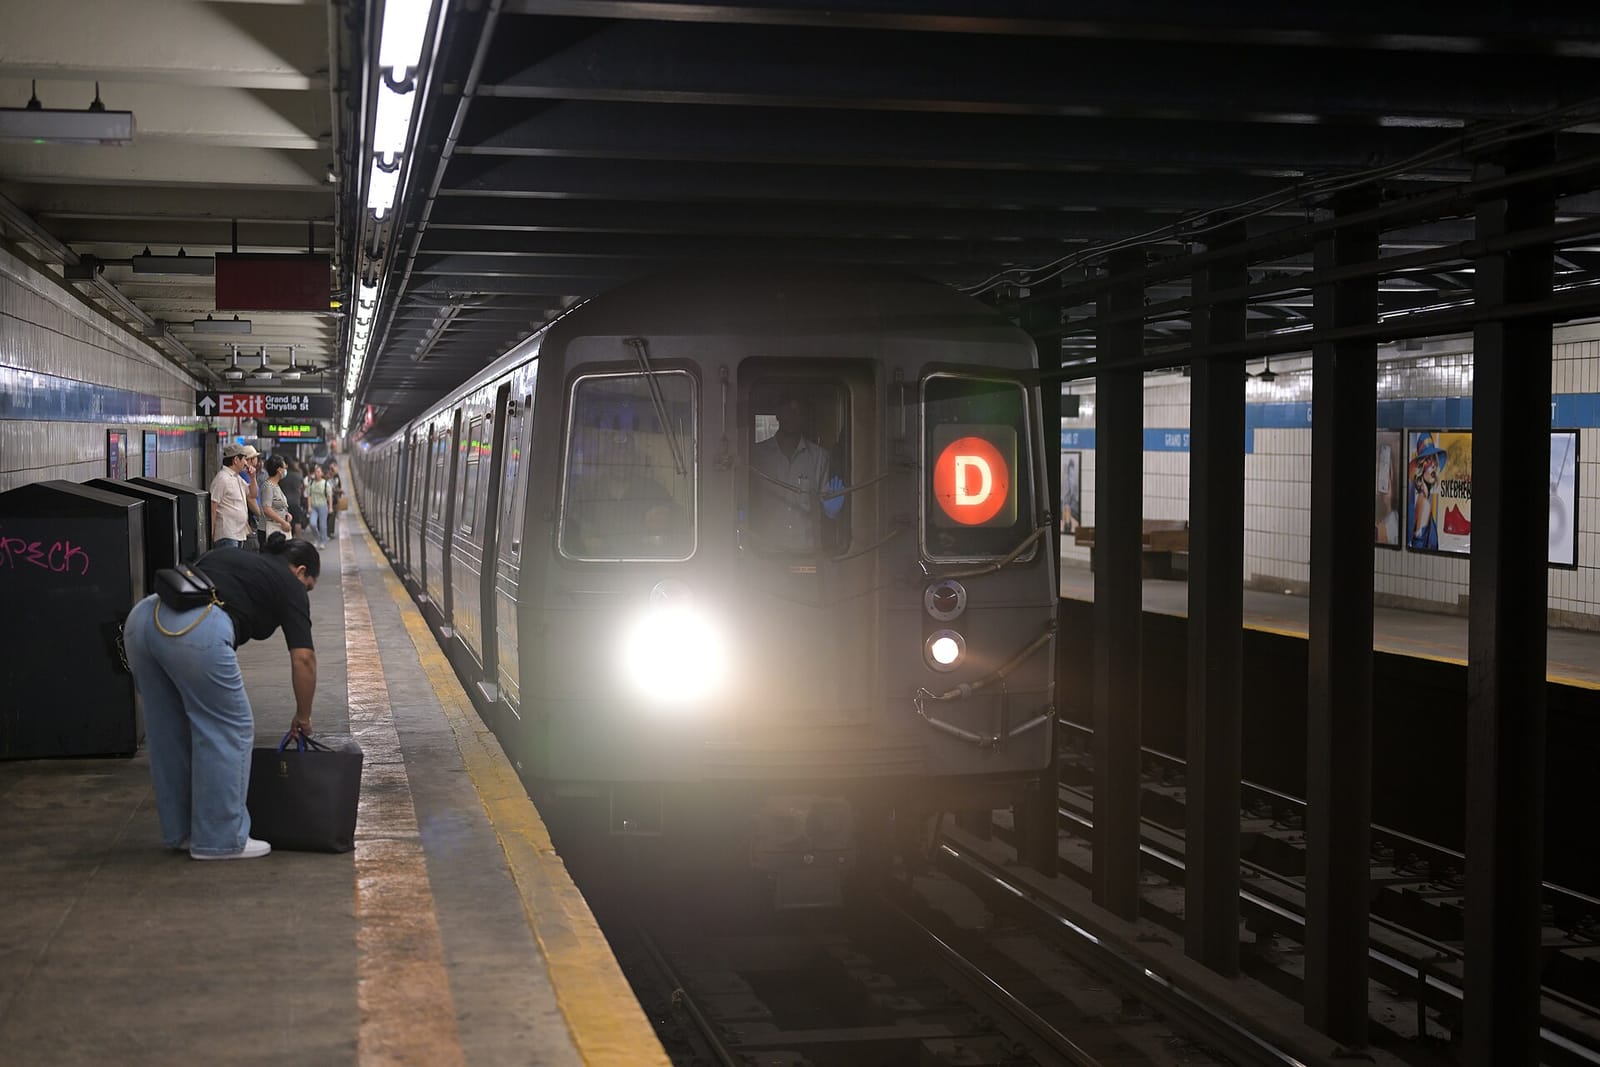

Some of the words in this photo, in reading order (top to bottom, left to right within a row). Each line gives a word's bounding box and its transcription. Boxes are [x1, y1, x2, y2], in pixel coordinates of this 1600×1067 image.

[219, 395, 264, 414] Exit
[265, 395, 289, 404] Grand
[291, 395, 300, 404] St
[265, 402, 297, 411] Chrystie
[300, 402, 309, 411] St
[955, 455, 993, 506] D
